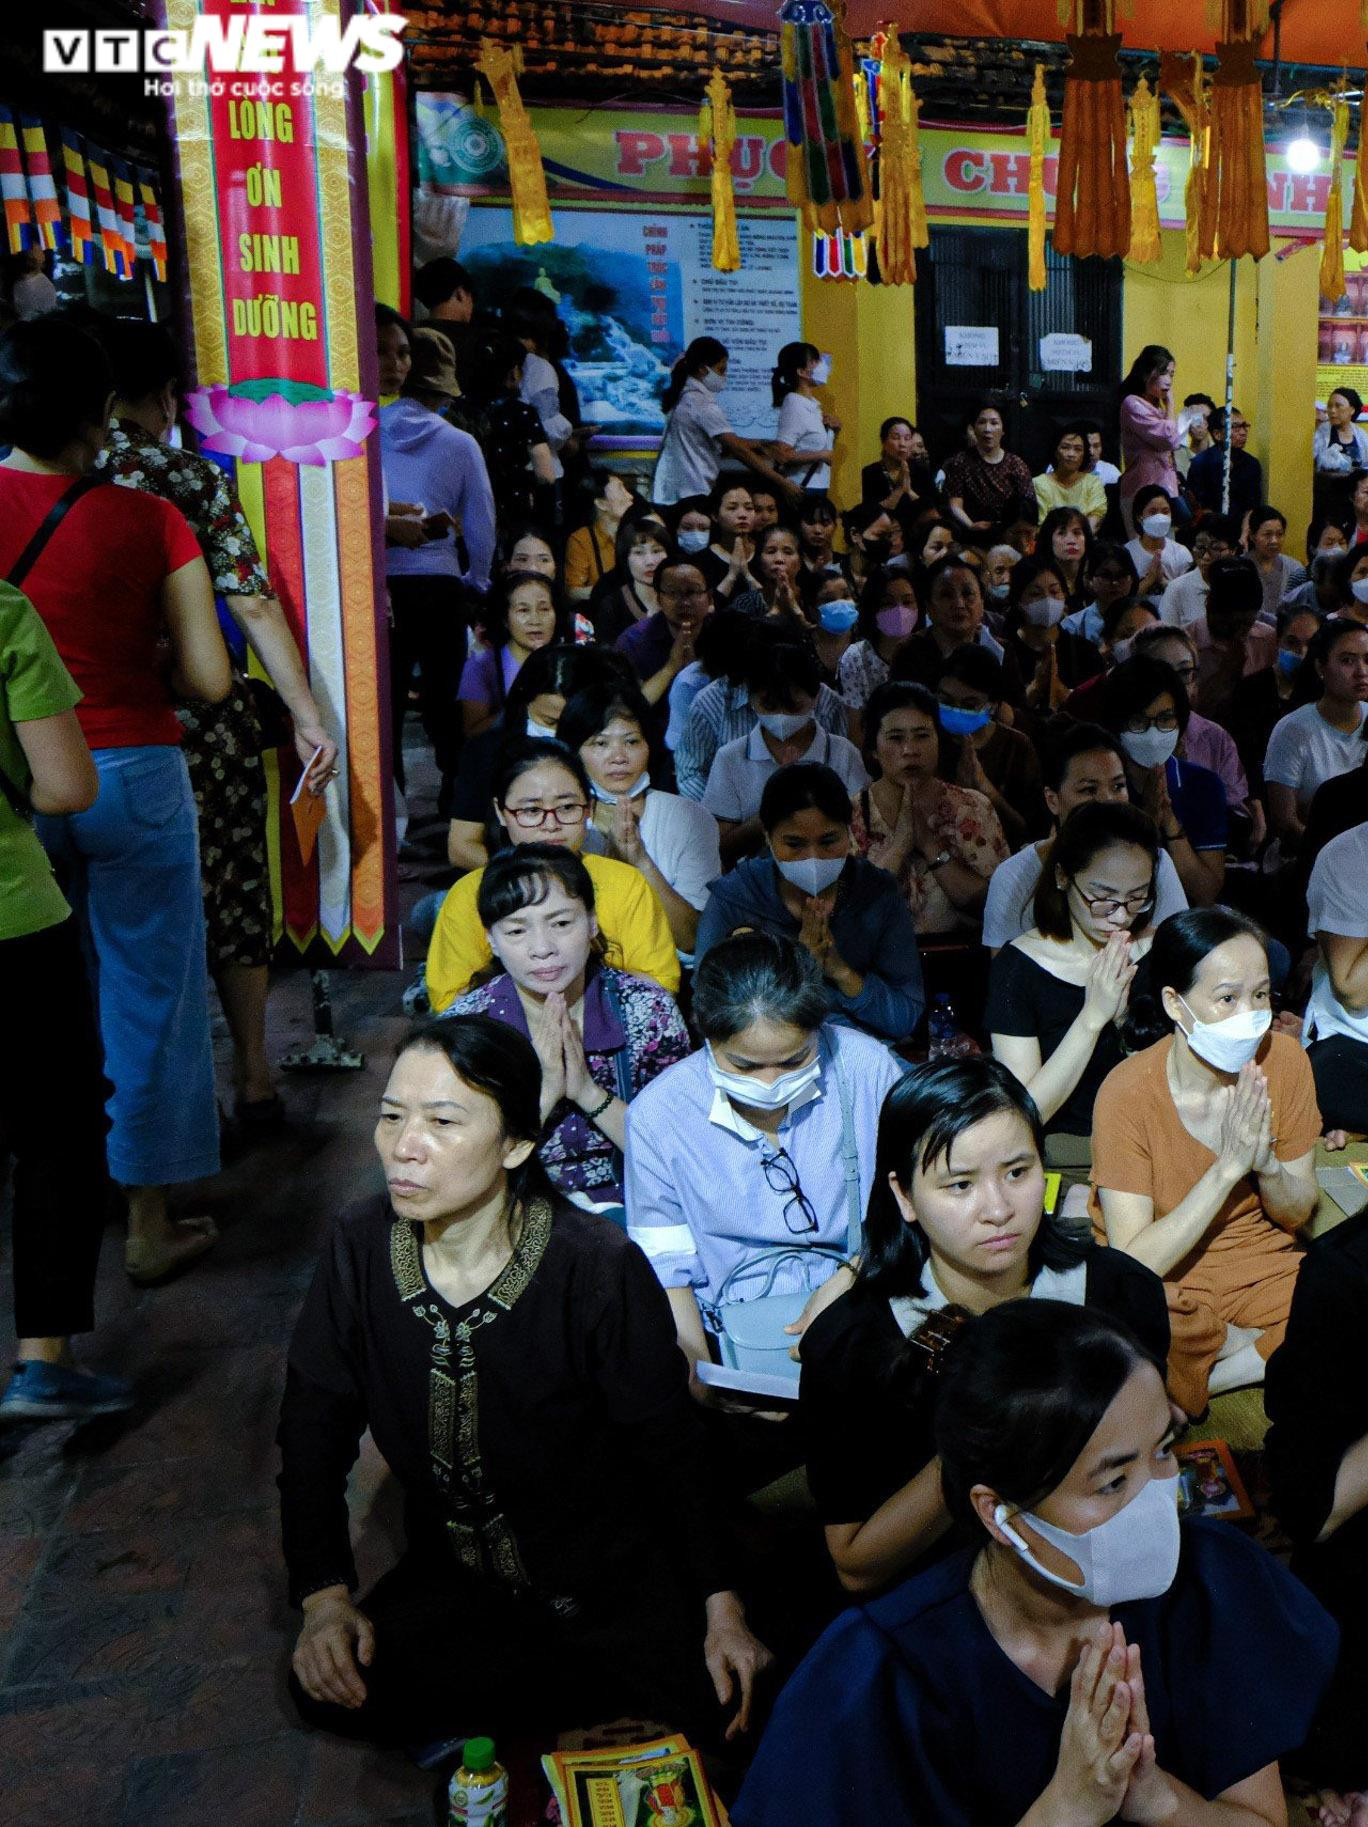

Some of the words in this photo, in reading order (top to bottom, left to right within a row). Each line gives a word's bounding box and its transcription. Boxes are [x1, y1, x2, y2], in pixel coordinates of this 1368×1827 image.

[228, 95, 293, 144] LÒNG
[246, 162, 282, 208] ƠN
[239, 233, 300, 275] SINH
[232, 294, 317, 340] DƯỠNG
